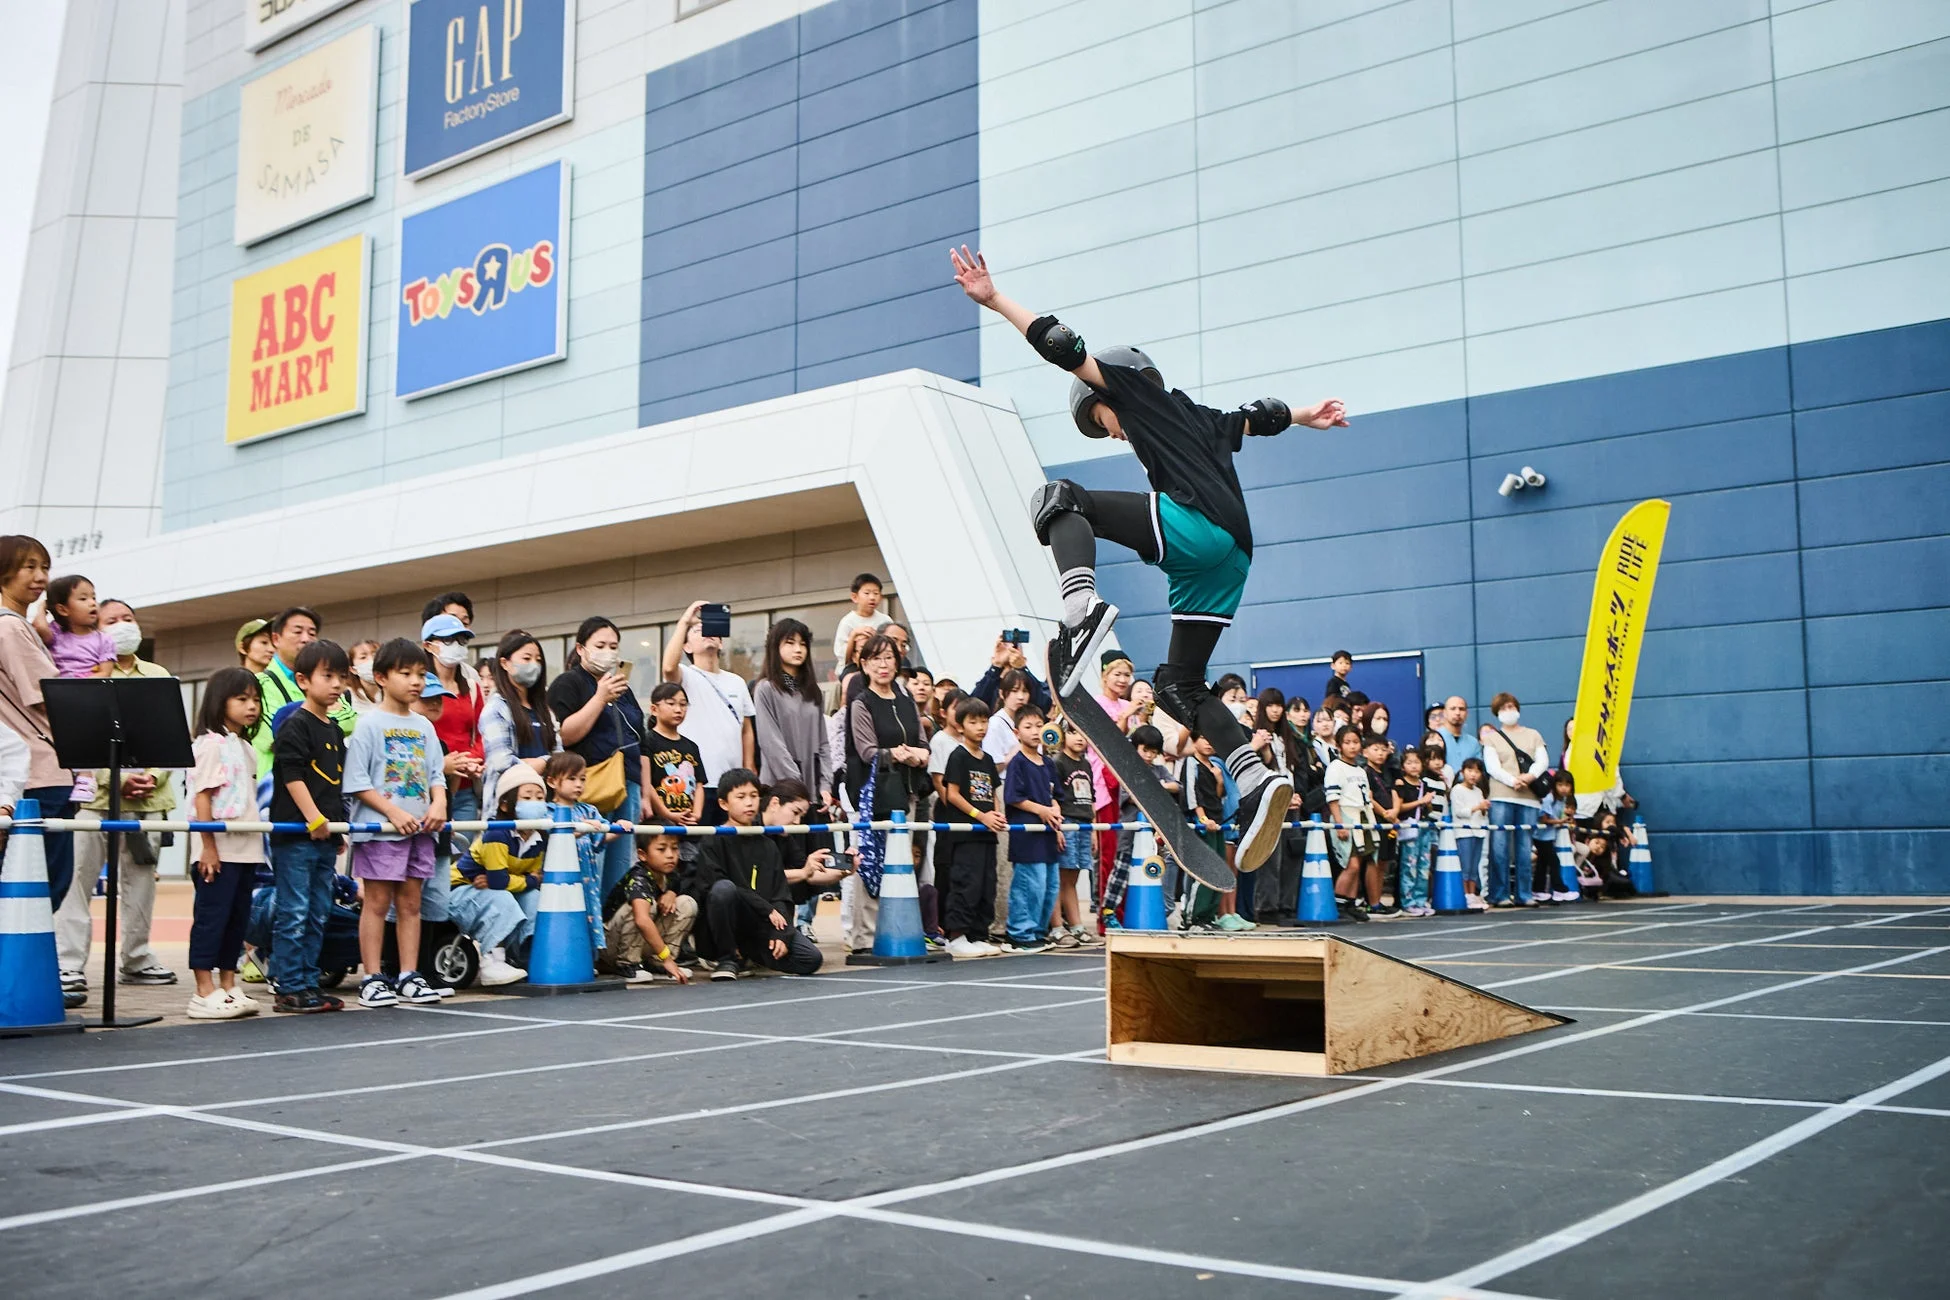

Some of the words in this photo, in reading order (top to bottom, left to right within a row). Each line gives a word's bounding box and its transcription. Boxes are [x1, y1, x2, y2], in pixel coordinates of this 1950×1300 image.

[445, 0, 523, 104] GAP
[292, 124, 311, 147] DE
[257, 137, 345, 199] SAMASA
[252, 272, 336, 362] ABC
[249, 346, 334, 412] MART
[1617, 530, 1636, 576] RIDE
[1628, 535, 1649, 582] LIFE
